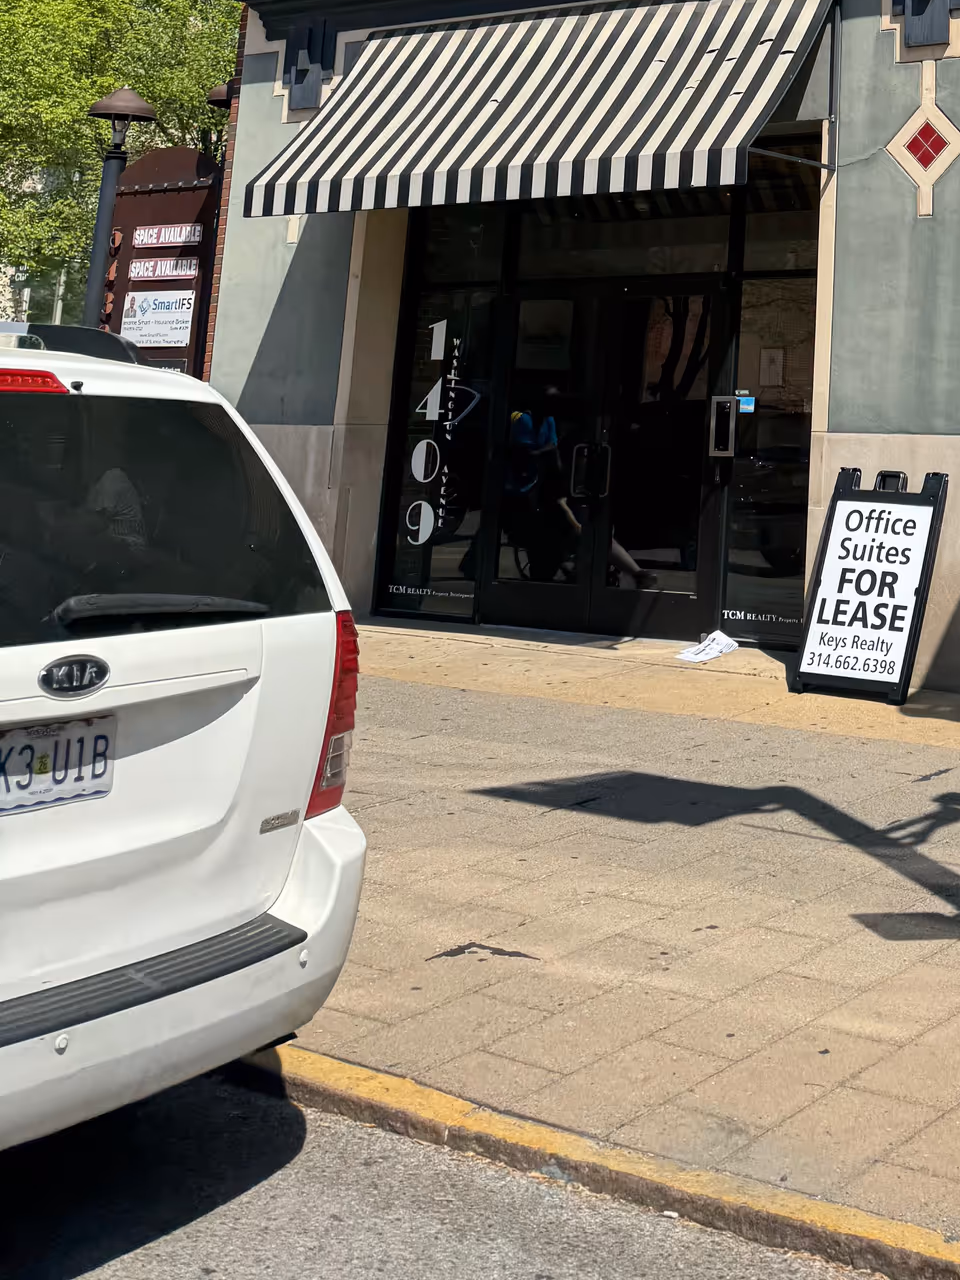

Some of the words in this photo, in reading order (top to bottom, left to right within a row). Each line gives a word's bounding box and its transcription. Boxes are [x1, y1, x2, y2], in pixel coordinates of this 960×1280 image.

[135, 227, 159, 245] SPACE
[159, 225, 200, 243] AVAILABLE
[130, 261, 154, 277] SPACE
[155, 260, 196, 276] AVAILABLE
[152, 297, 192, 311] SmartIFS
[438, 465, 448, 527] AVENUE
[845, 509, 917, 536] Office
[838, 537, 912, 565] Suites
[388, 585, 406, 594] TCM
[837, 568, 899, 598] FOR
[722, 610, 744, 620] TCM
[746, 613, 777, 622] REALTY
[816, 598, 908, 632] LEASE
[819, 631, 848, 651] Keys
[851, 635, 893, 657] Realty
[50, 663, 101, 689] KIA
[807, 652, 896, 675] 314.662.6398
[52, 734, 109, 785] U1B
